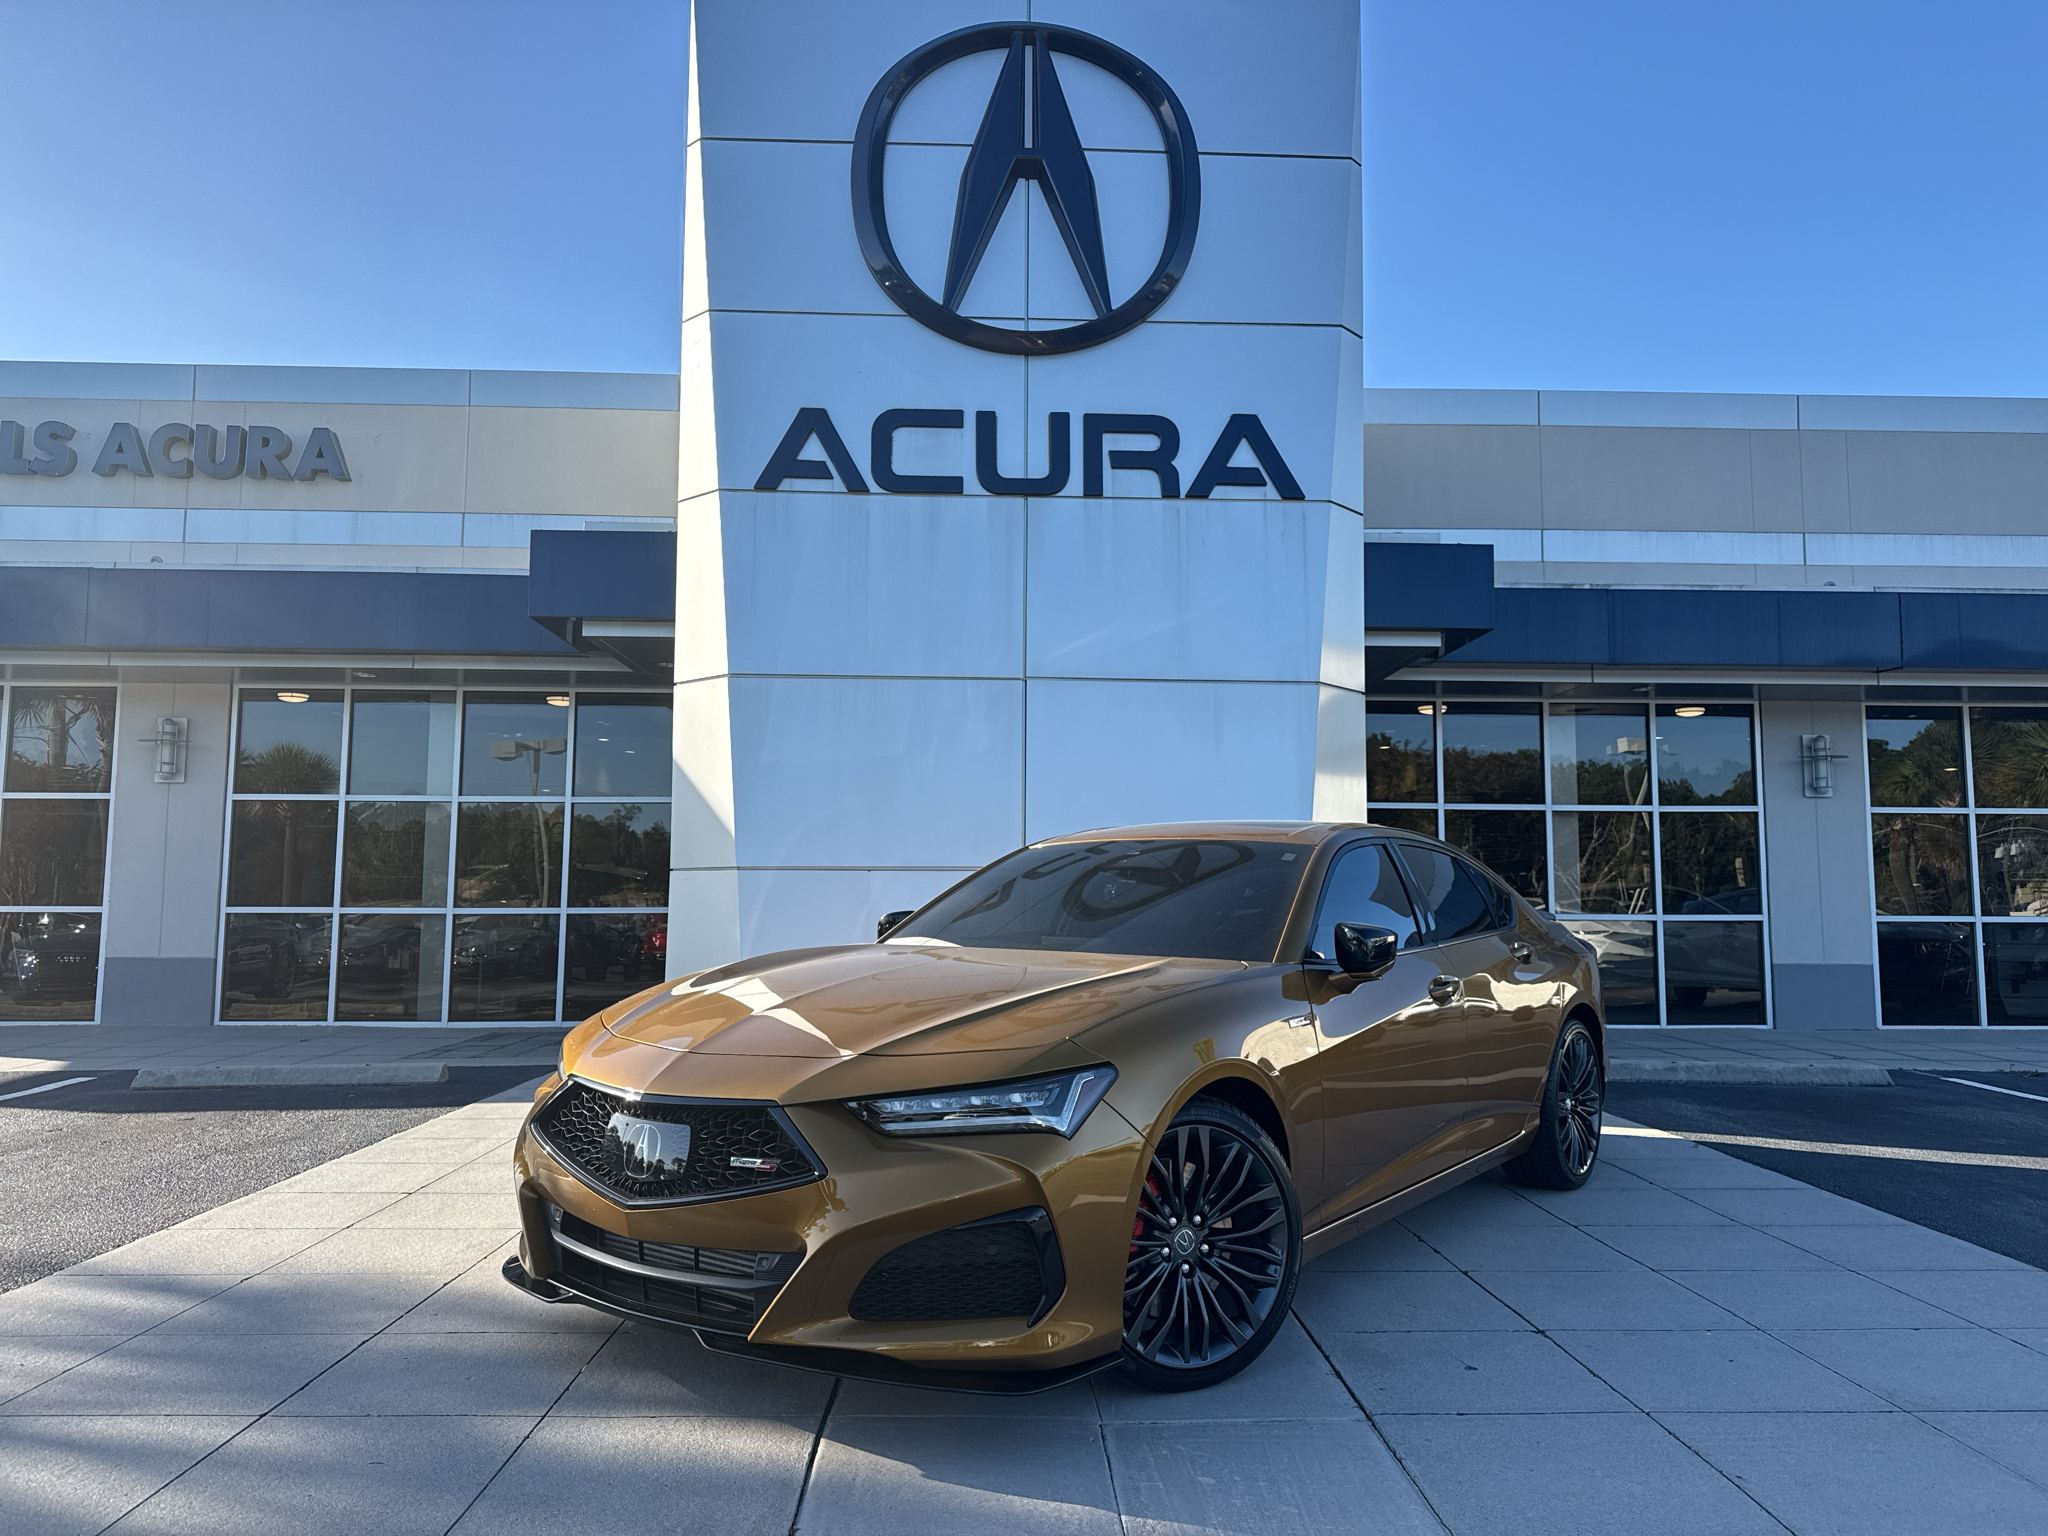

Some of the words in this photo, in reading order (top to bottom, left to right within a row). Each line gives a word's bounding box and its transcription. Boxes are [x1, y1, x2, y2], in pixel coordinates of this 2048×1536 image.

[0, 420, 78, 477] LS
[91, 421, 352, 482] ACURA
[754, 407, 1306, 500] ACURA
